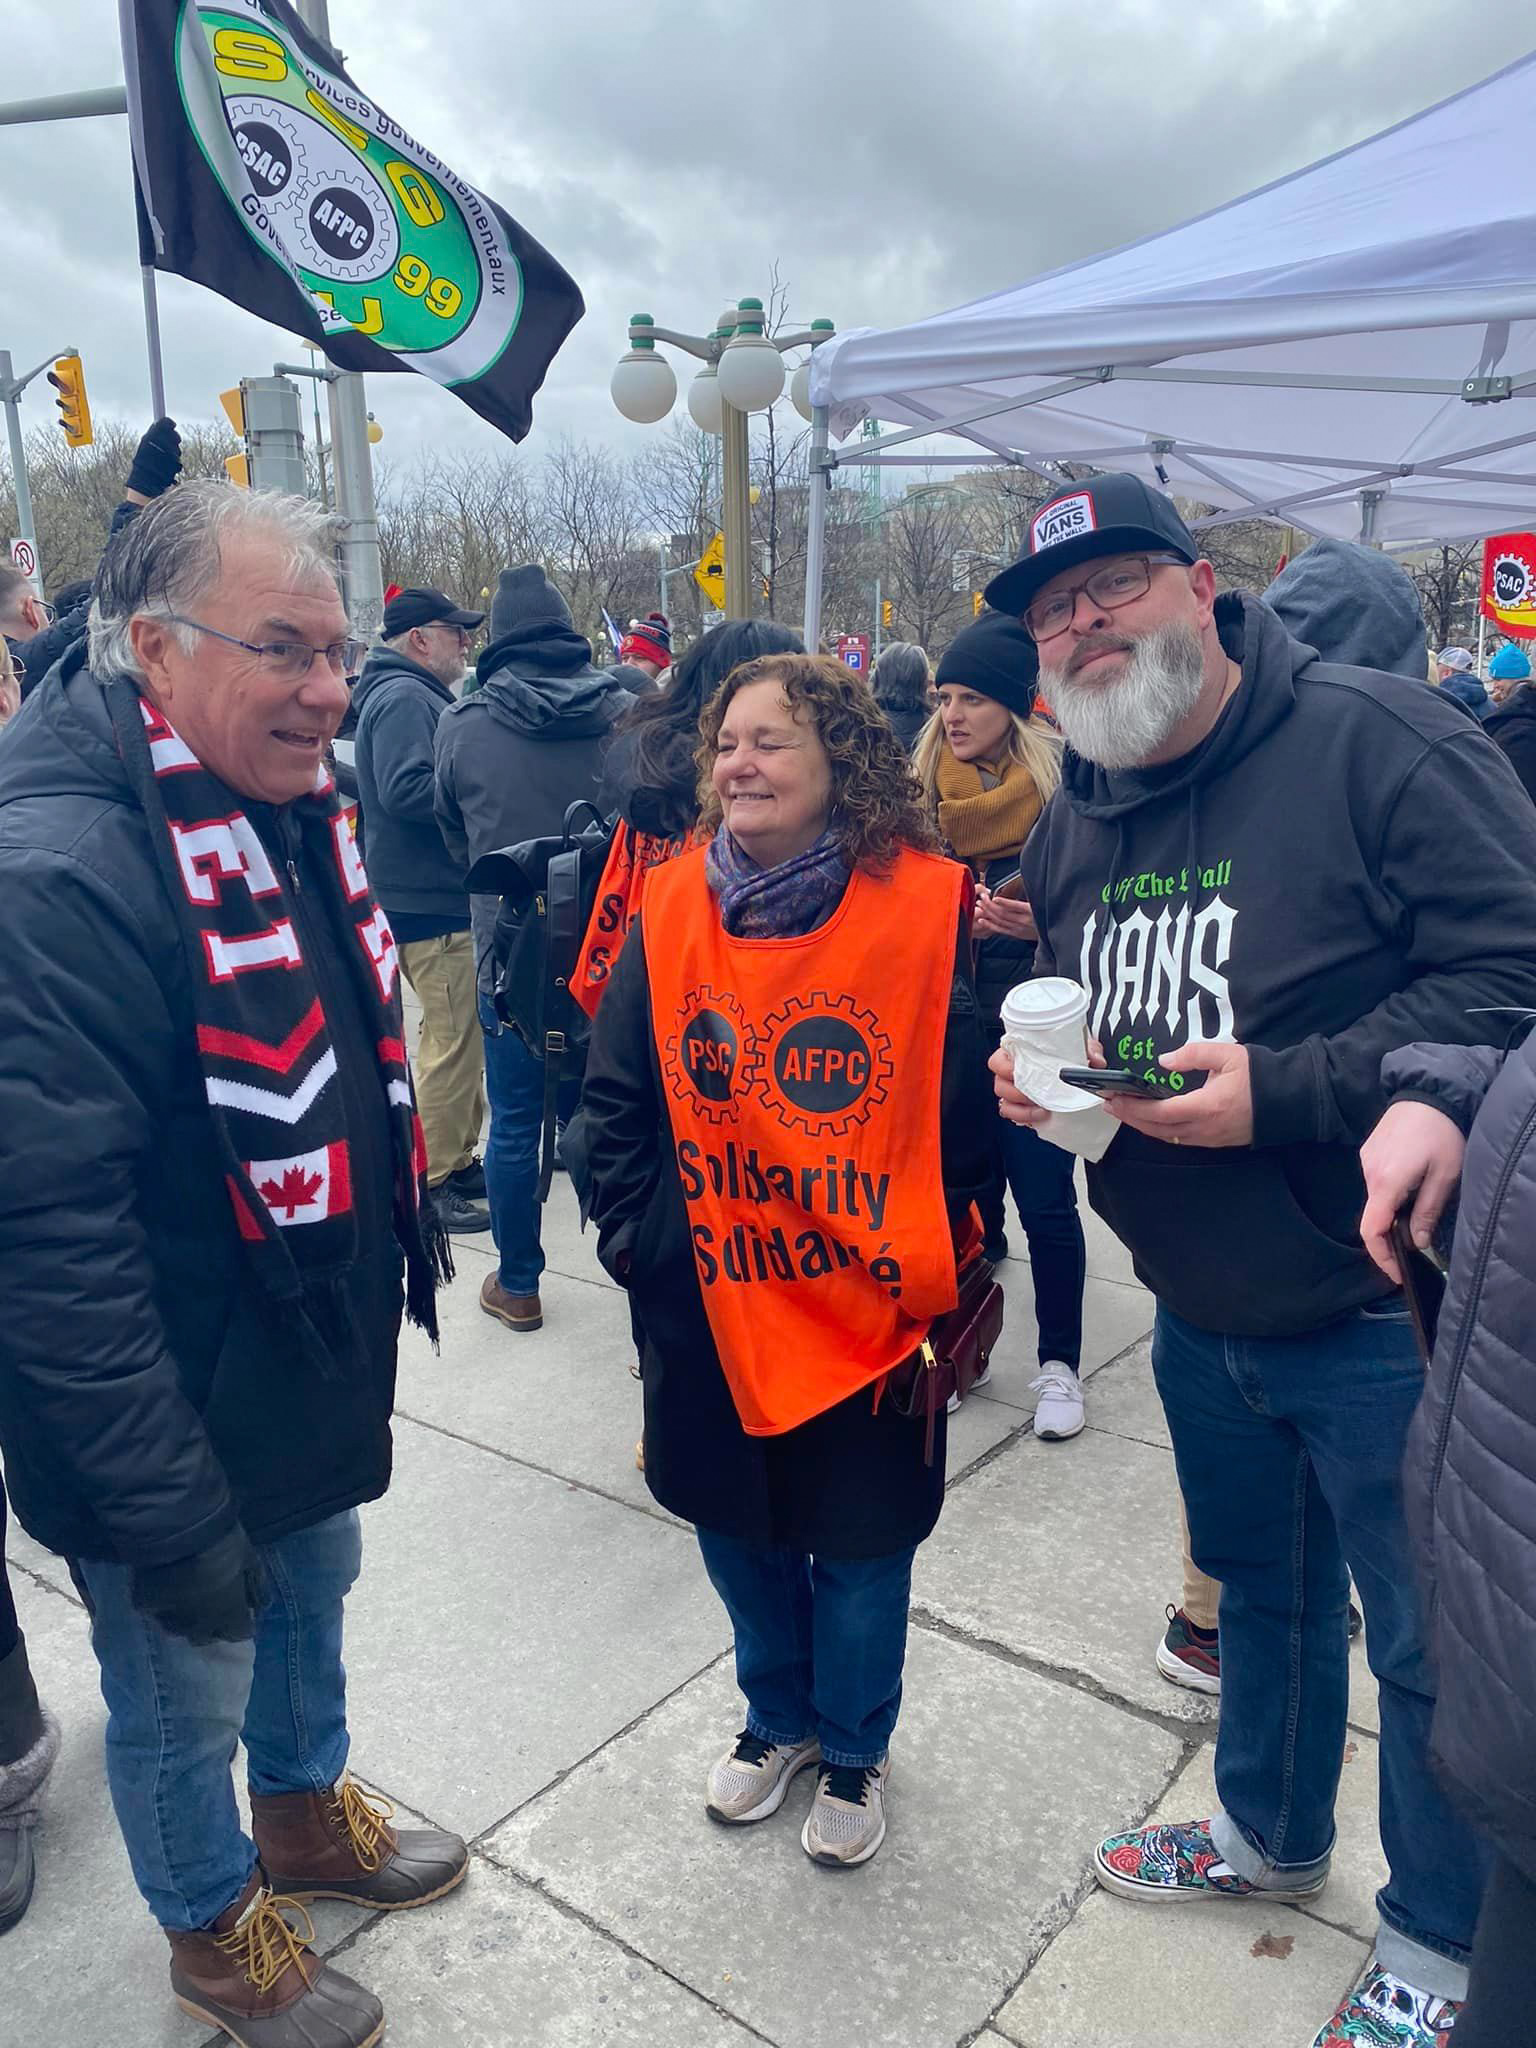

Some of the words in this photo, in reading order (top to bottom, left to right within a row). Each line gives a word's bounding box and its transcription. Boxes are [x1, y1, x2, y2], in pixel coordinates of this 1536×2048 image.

[235, 130, 287, 187] PSAC
[314, 199, 369, 251] AFPC
[376, 112, 506, 296] gouvernementaux
[393, 254, 463, 320] 99
[1036, 505, 1085, 543] VANS
[1496, 570, 1523, 593] PSAC
[1134, 871, 1175, 899] The
[1080, 892, 1240, 1045] VANS
[783, 1047, 866, 1086] AFPC
[1117, 1034, 1154, 1060] Est
